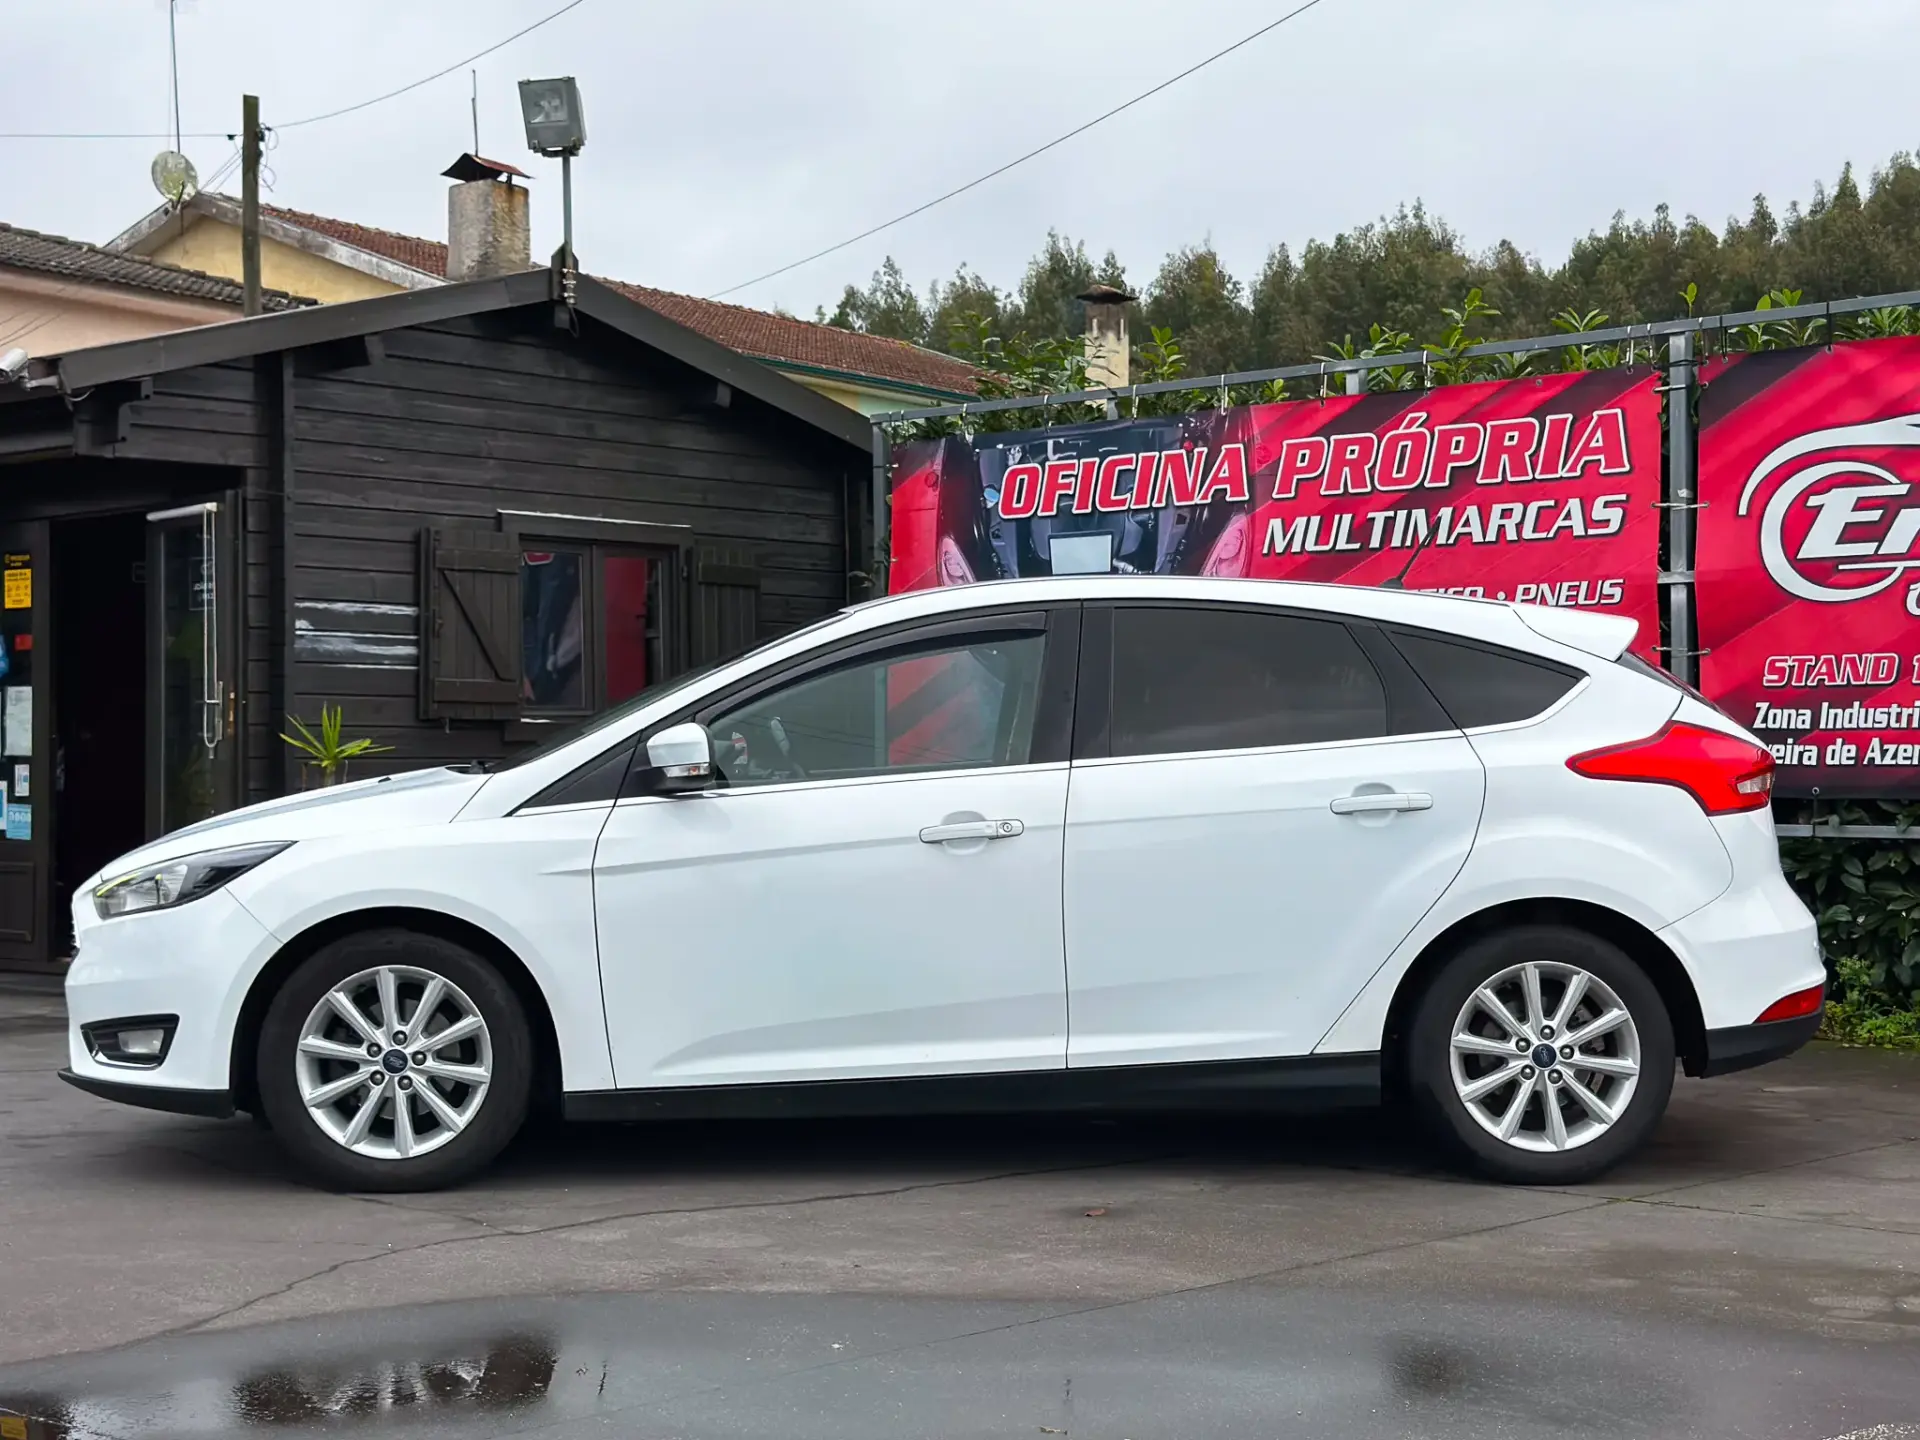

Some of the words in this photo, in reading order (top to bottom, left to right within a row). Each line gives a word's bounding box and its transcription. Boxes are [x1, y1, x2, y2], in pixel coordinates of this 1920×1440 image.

[998, 443, 1250, 520] OFICINA
[1272, 409, 1631, 499] PRÓPRIA
[1262, 493, 1628, 555] MULTIMARCAS
[1514, 578, 1625, 607] PNEUS
[1762, 652, 1900, 687] STAND
[1753, 702, 1813, 730] Zona
[1768, 738, 1818, 766] eira
[1825, 738, 1857, 766] de
